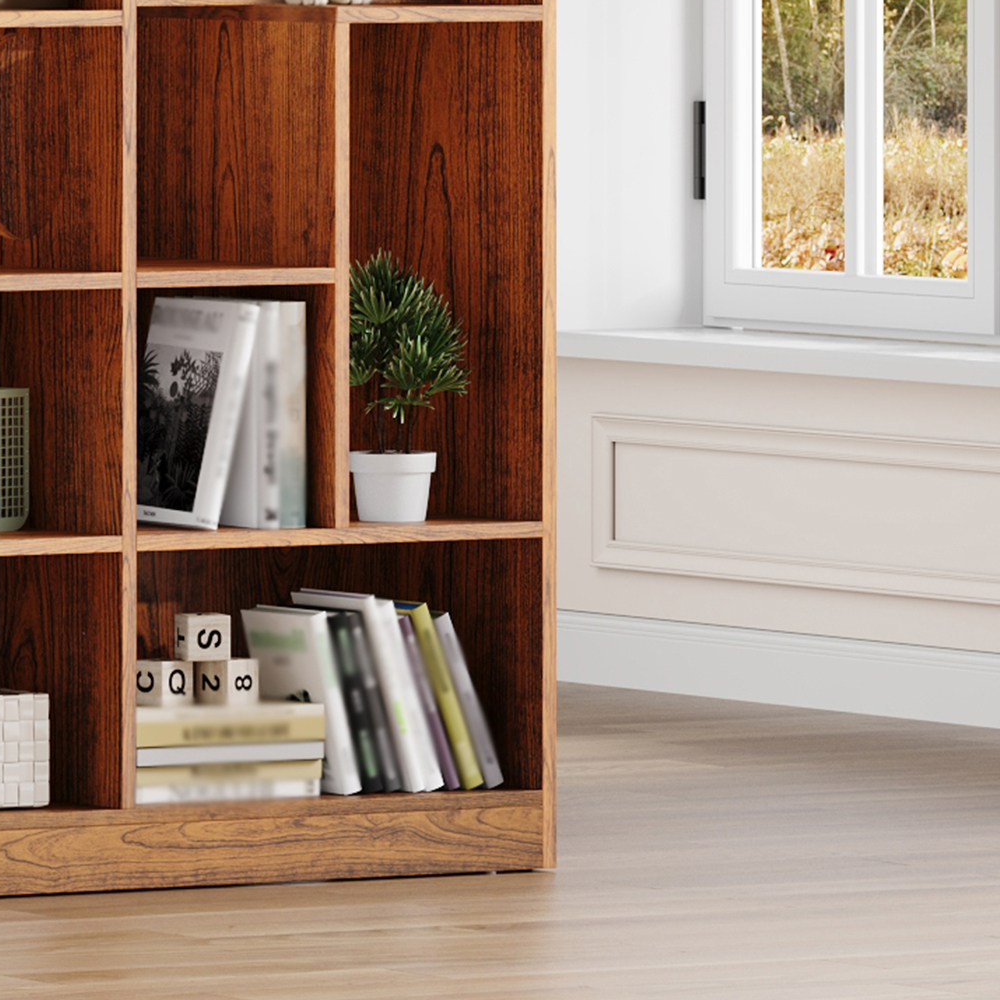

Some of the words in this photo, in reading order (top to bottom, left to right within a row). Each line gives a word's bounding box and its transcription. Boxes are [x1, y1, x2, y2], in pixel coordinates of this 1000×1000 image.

[177, 627, 185, 647] T
[197, 629, 222, 649] S
[136, 671, 154, 693] C
[169, 669, 186, 696] Q
[202, 673, 220, 691] 2
[235, 674, 252, 691] 8
